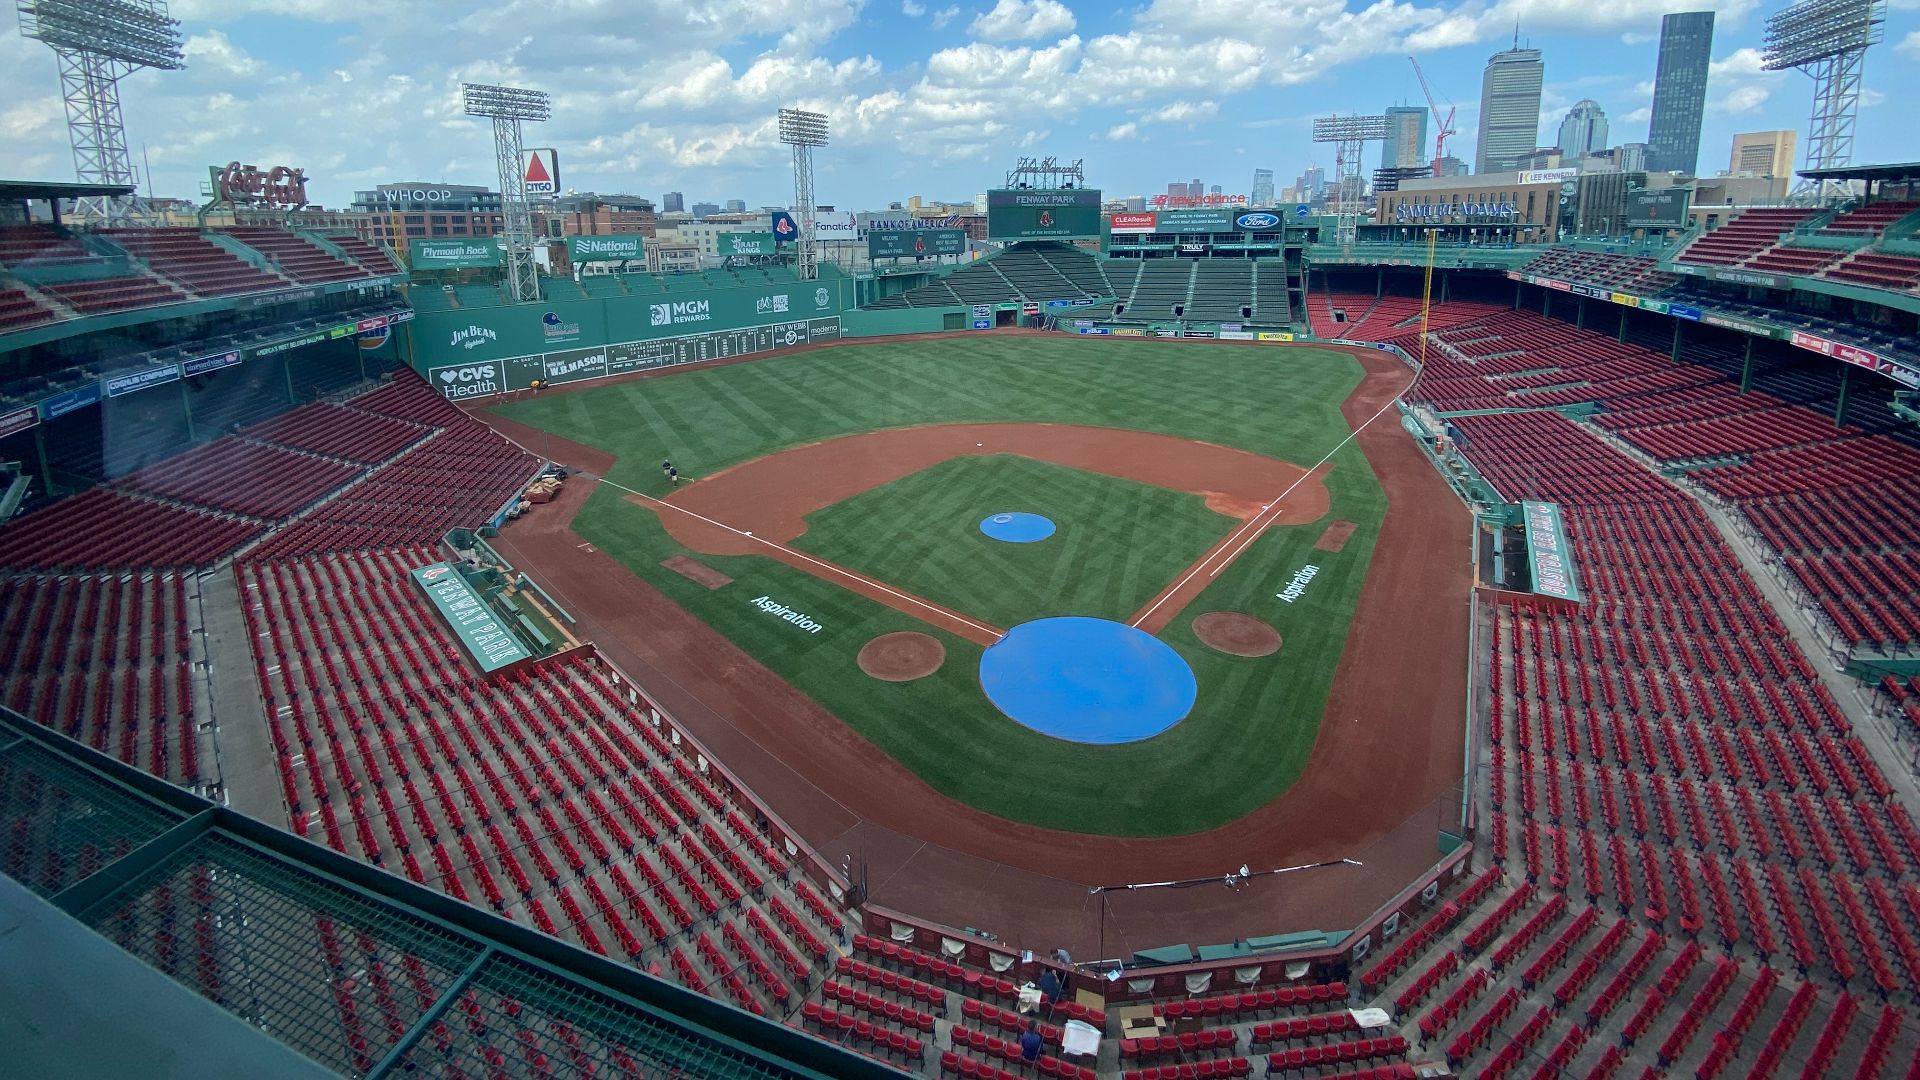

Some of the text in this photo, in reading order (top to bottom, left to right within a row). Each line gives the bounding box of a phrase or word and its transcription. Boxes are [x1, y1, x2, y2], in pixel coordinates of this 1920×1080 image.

[1531, 173, 1542, 181] LEE
[526, 182, 551, 191] CITGO
[383, 189, 451, 201] WHOOP
[1016, 196, 1075, 204] FENWAY PARK
[1396, 201, 1514, 219] SAMUEL ADAMS
[816, 222, 852, 231] Fanatics
[870, 219, 948, 229] BANK OF AMERICA
[1244, 215, 1271, 226] Ford
[591, 240, 637, 252] National
[733, 241, 760, 249] DRAFT
[423, 245, 488, 258] Plymouth Rock
[673, 300, 709, 315] MGM
[787, 322, 806, 331] WEBB
[810, 325, 838, 334] moderna
[450, 325, 497, 346] JIM BEAM
[187, 357, 225, 372] vineyard vines
[458, 364, 495, 382] CVS
[443, 379, 497, 398] Health
[1536, 551, 1568, 596] BOSTON
[1275, 564, 1320, 603] Aspiration
[433, 577, 520, 664] FENWAY PARK
[750, 595, 823, 634] Aspiration
